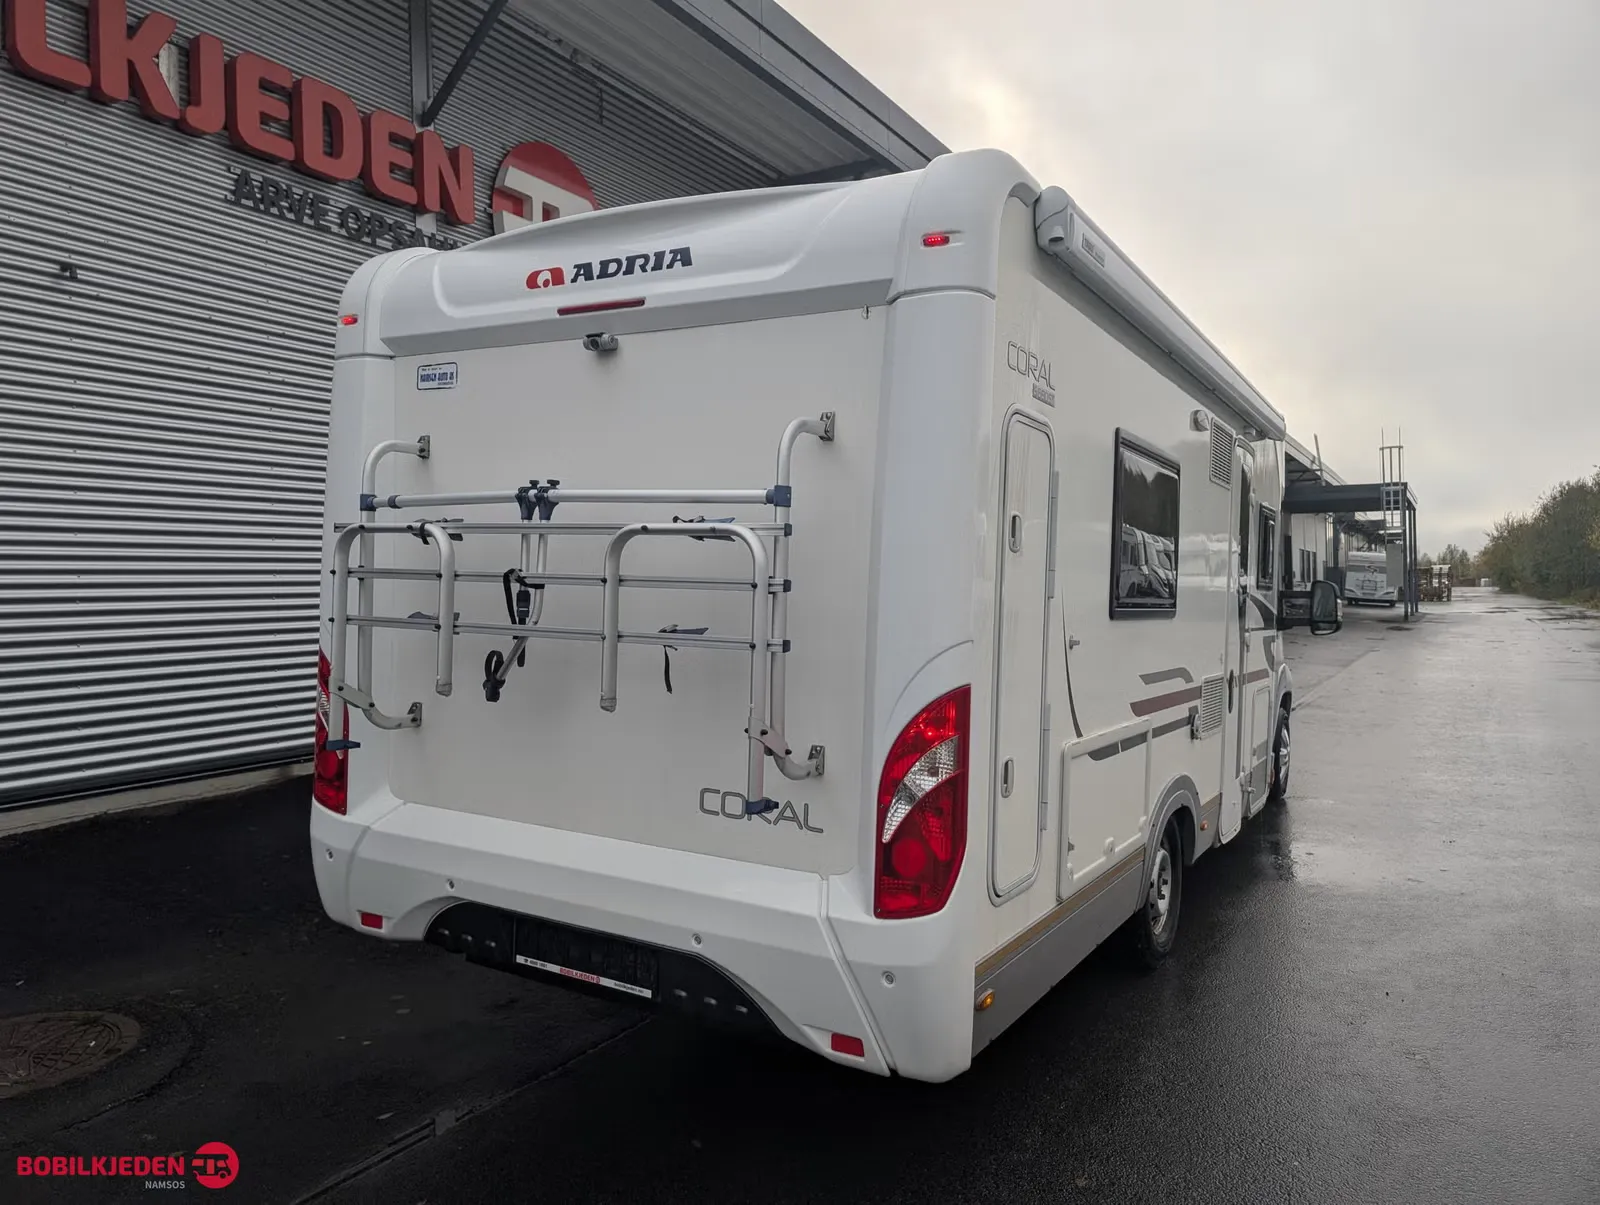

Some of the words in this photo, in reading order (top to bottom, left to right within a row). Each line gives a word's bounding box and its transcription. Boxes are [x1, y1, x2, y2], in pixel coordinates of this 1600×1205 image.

[233, 169, 332, 233] ARVE
[570, 247, 693, 284] ADRIA
[1007, 340, 1056, 391] CORAL
